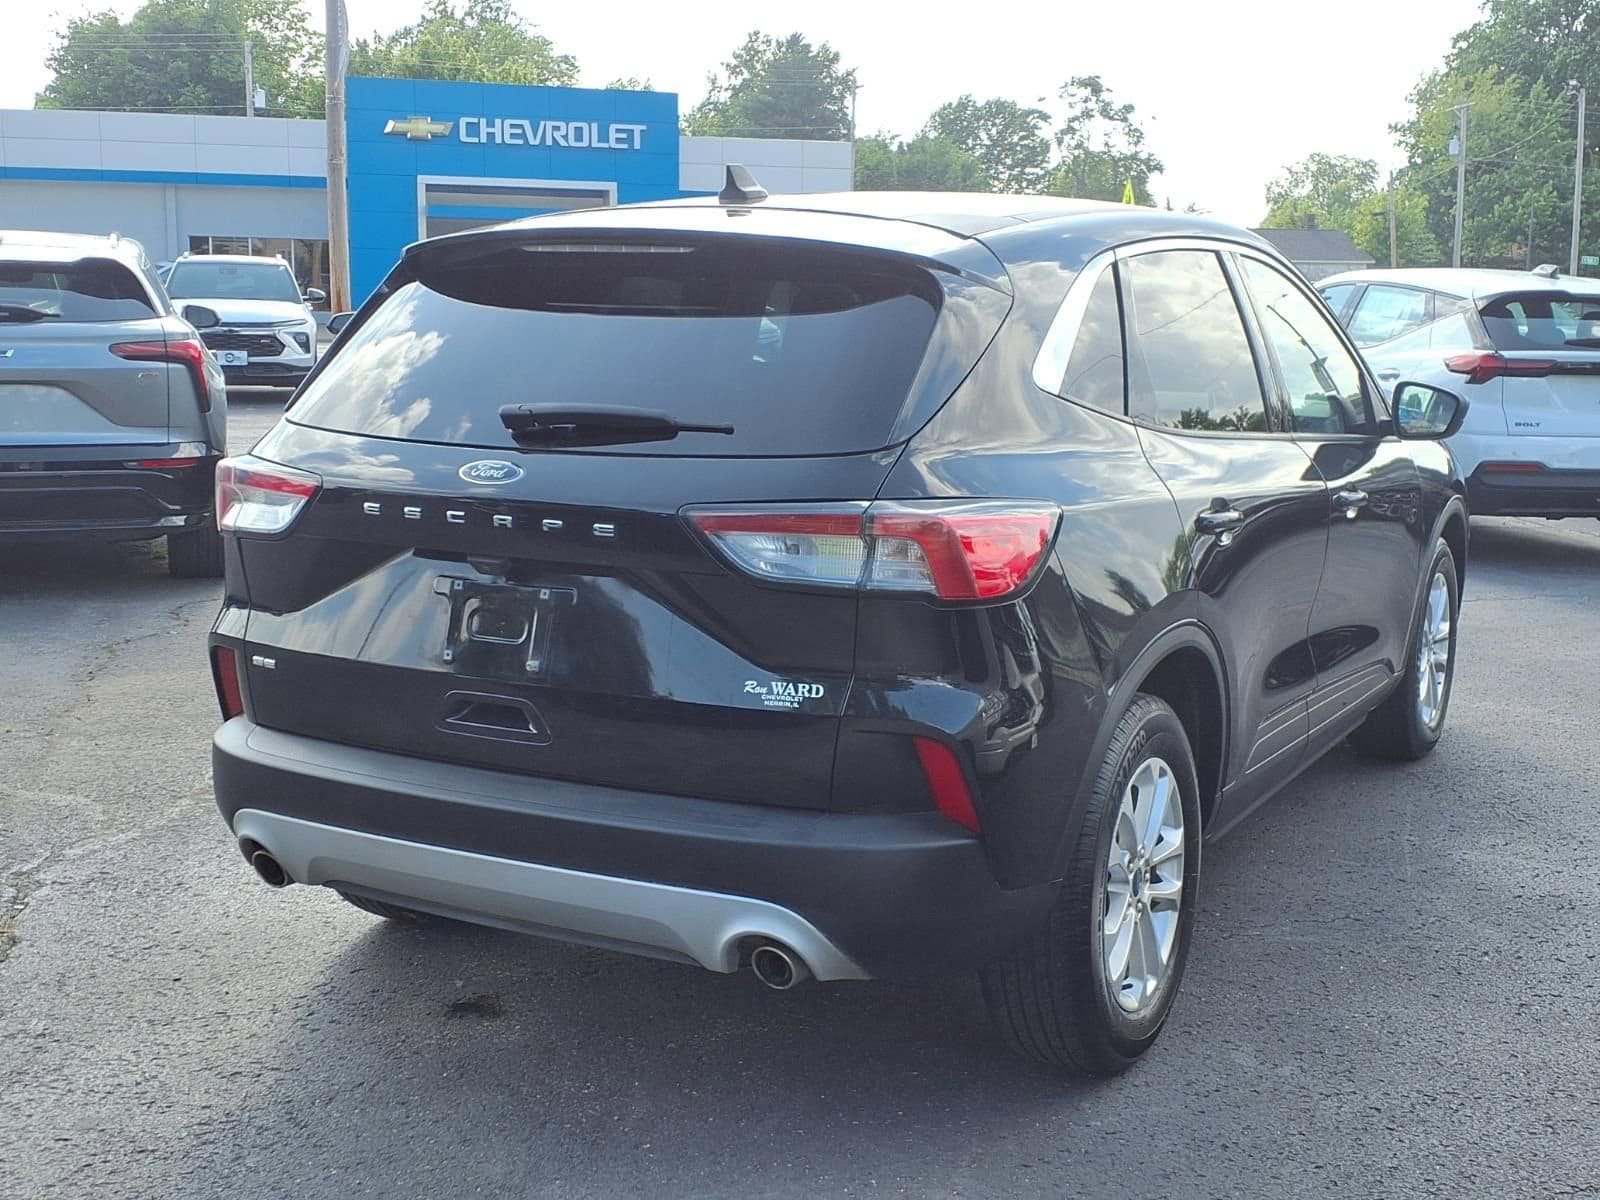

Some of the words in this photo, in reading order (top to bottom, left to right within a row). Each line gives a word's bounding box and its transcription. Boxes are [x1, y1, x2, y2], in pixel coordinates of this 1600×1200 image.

[459, 117, 647, 150] CHEVROLET
[471, 462, 509, 478] Ford
[363, 502, 615, 536] ESCAPE
[743, 680, 768, 693] Ron
[771, 681, 824, 698] WARD
[761, 694, 804, 703] CHEVROLET
